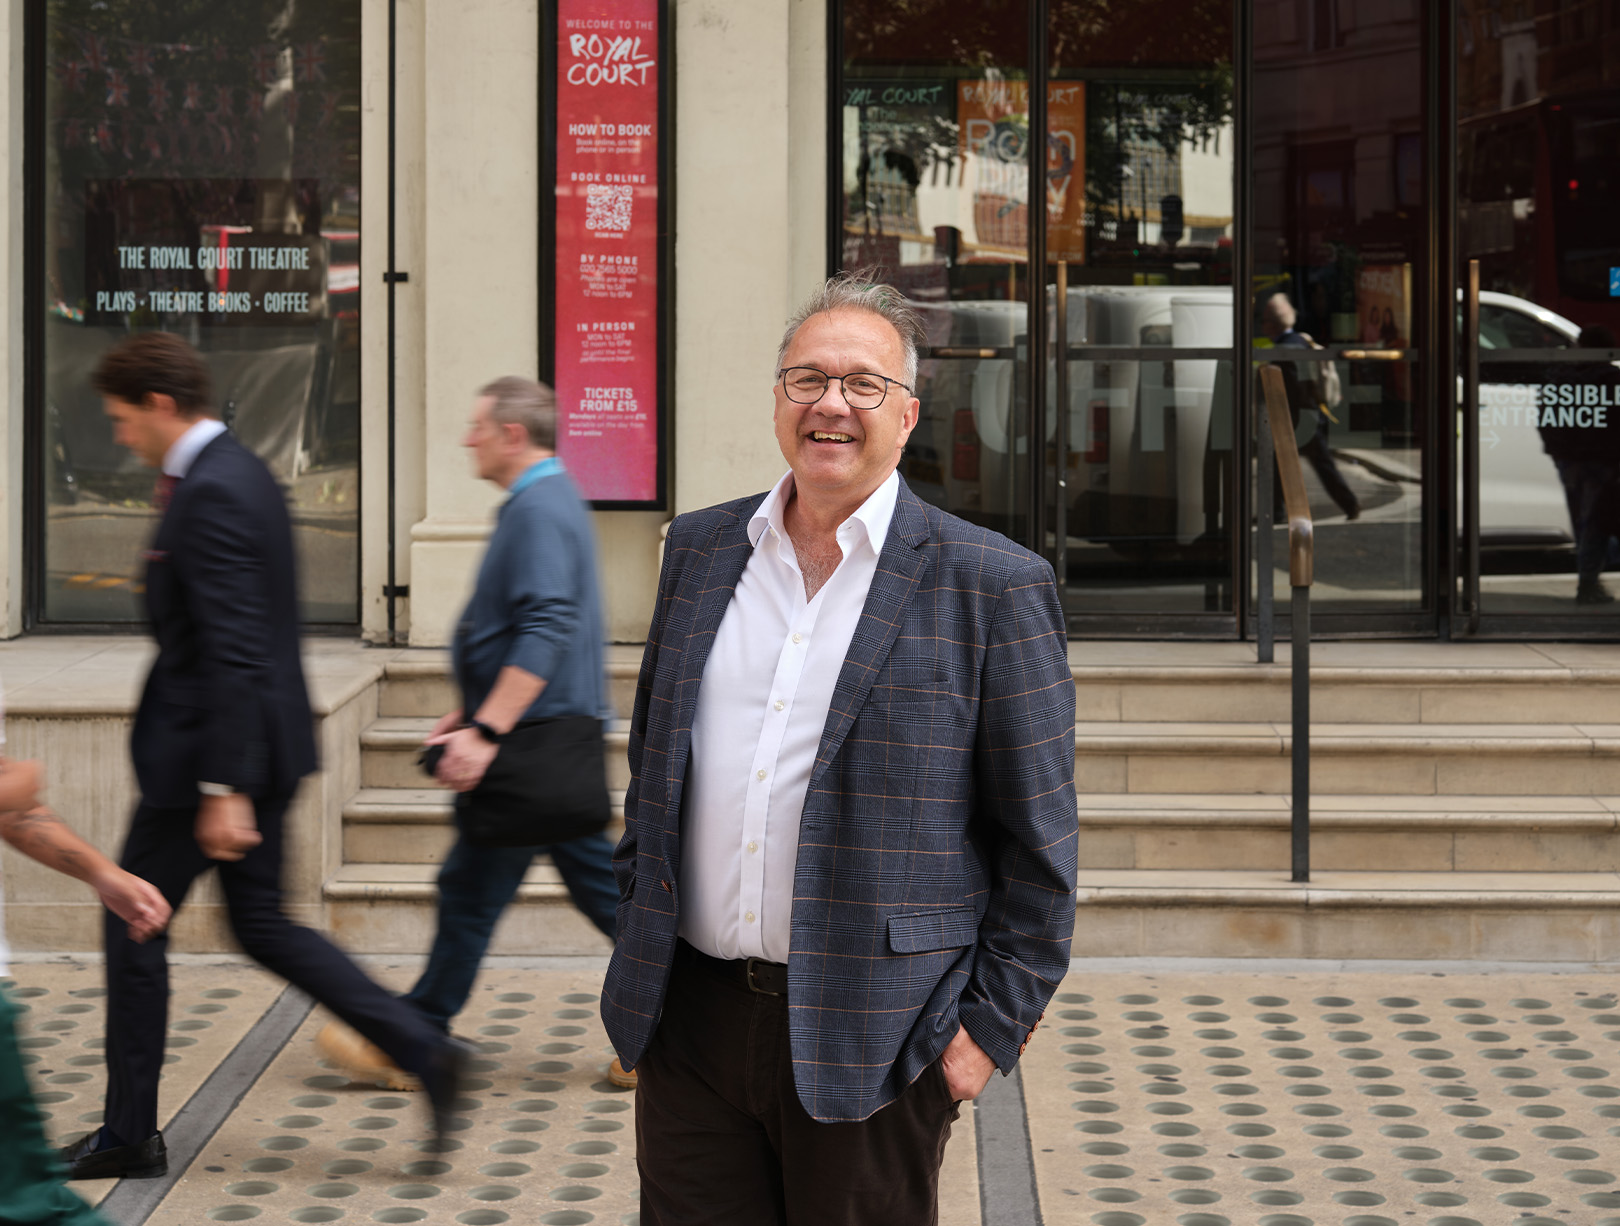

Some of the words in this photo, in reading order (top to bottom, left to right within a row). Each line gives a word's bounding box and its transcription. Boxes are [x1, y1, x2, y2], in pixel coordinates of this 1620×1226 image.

[566, 19, 615, 29] WELCOME
[619, 20, 632, 30] TO
[635, 20, 654, 30] THE
[569, 33, 648, 66] ROYAL
[567, 60, 655, 87] COURT
[882, 85, 944, 105] COURT
[569, 124, 597, 136] HOW
[600, 124, 615, 136] TO
[618, 124, 652, 136] BOOK
[571, 172, 600, 181] BOOK
[605, 173, 646, 184] ONLINE
[118, 246, 146, 269] THE
[150, 246, 193, 270] ROYAL
[197, 247, 244, 270] COURT
[249, 247, 310, 270] THEATRE
[580, 254, 595, 264] BY
[600, 255, 638, 265] PHONE
[96, 291, 136, 312] PLAYS
[149, 292, 204, 312] THEATRE
[208, 292, 251, 313] BOOKS
[264, 292, 309, 313] COFFEE
[577, 323, 588, 332] IN
[593, 321, 635, 332] PERSON
[584, 387, 634, 399] TICKETS
[580, 399, 614, 412] FROM
[616, 400, 638, 412] £15
[1479, 406, 1608, 428] ENTRANCE
